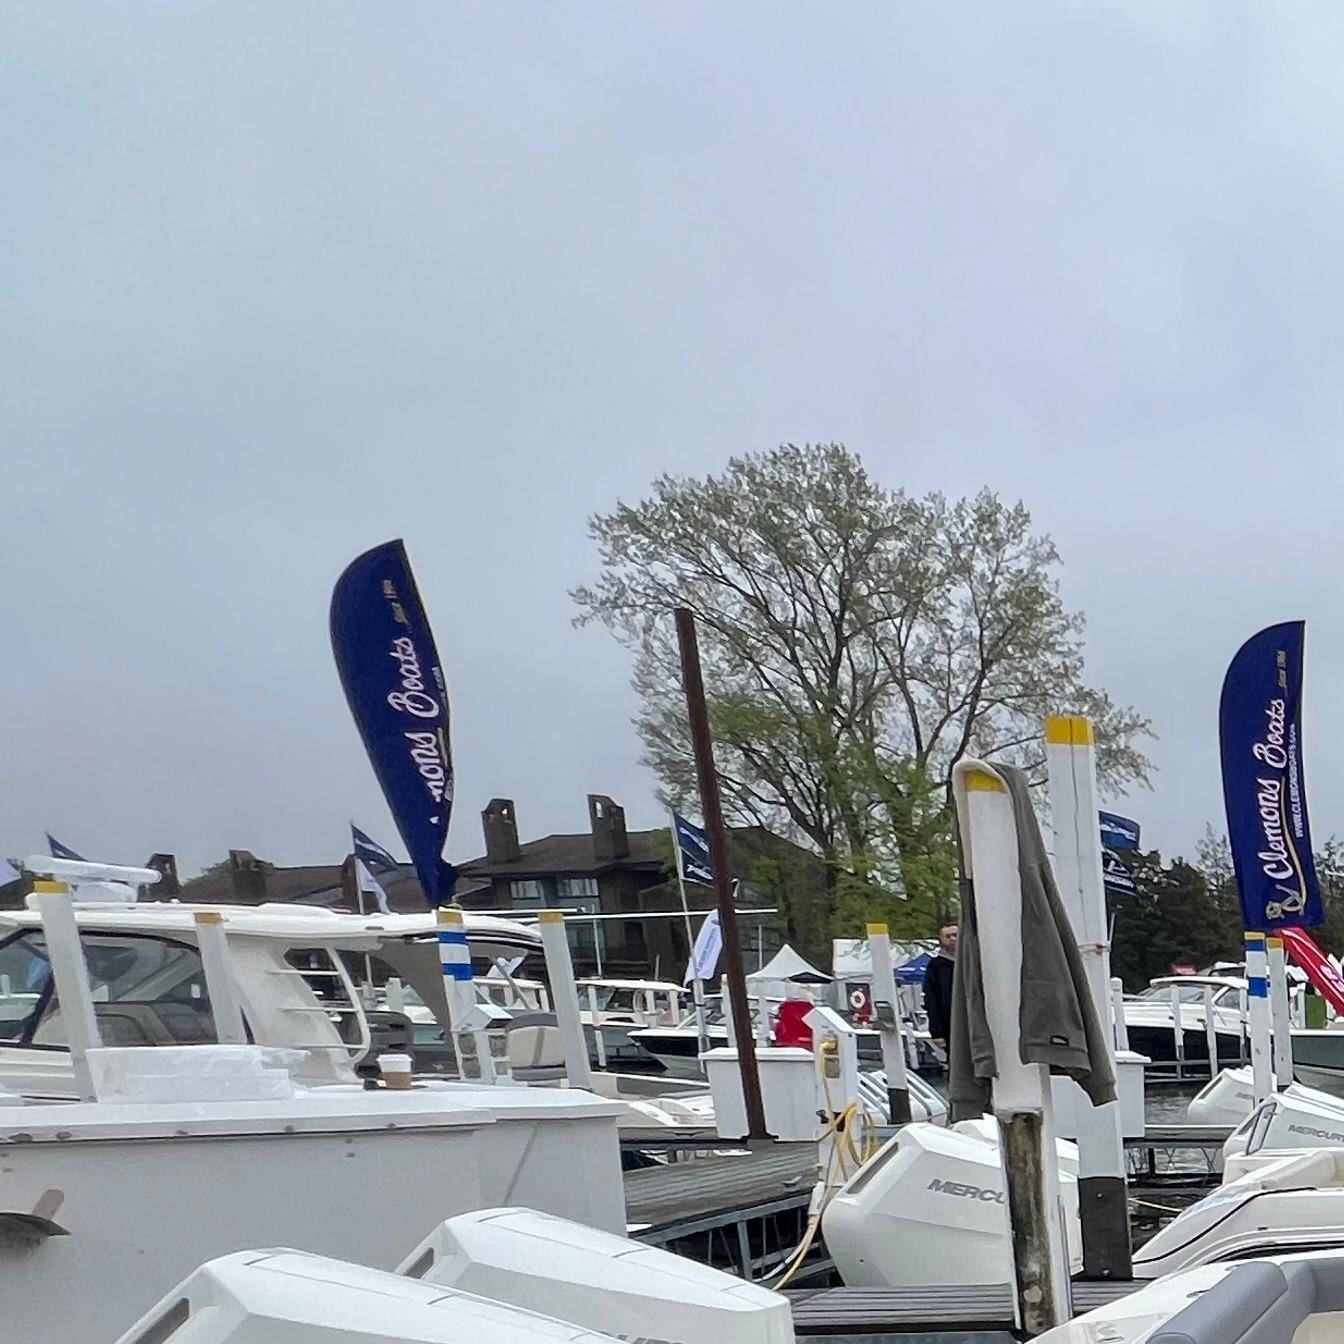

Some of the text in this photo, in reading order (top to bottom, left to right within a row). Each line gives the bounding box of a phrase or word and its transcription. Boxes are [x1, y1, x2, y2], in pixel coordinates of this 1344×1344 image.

[387, 636, 440, 719] Boats
[1252, 698, 1287, 768] Boats
[1257, 777, 1294, 880] Clemons
